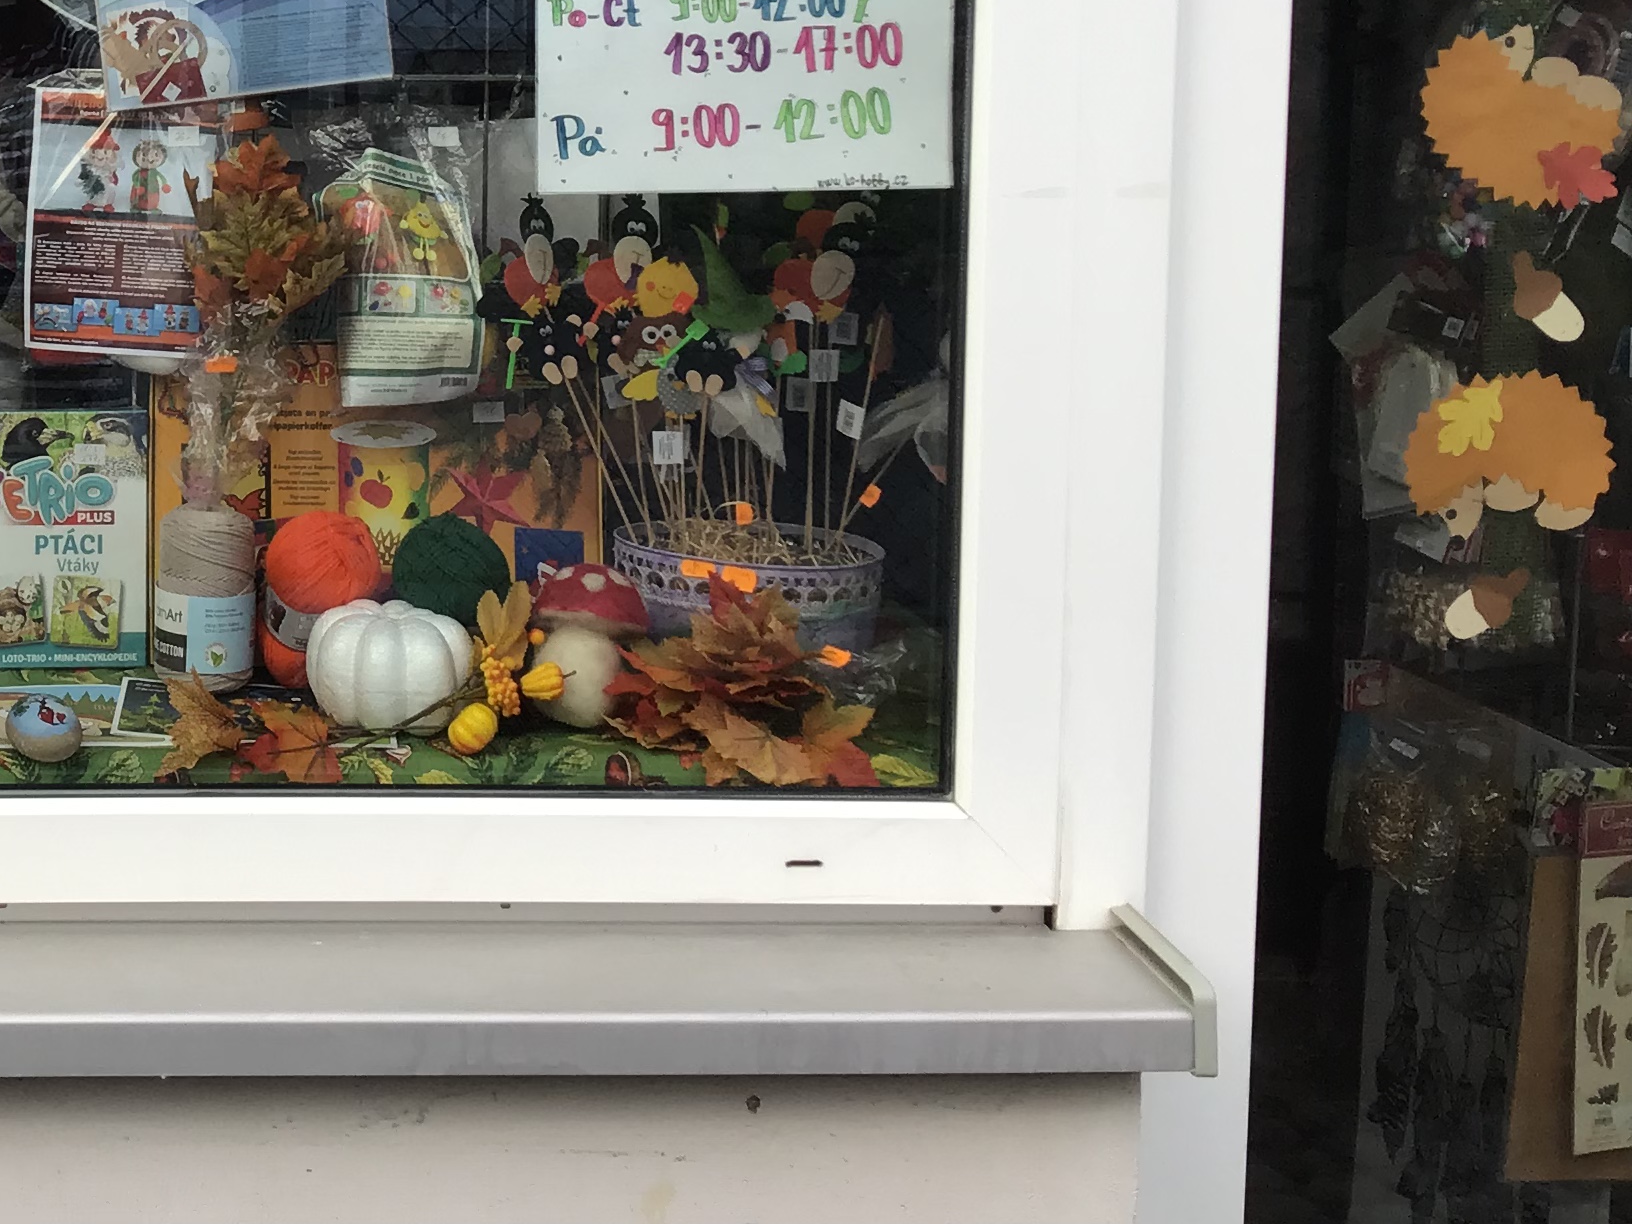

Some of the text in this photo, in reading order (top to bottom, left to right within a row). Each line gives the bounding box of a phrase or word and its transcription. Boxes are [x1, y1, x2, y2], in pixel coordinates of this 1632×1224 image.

[77, 511, 113, 523] PLUS
[35, 533, 103, 555] PTÁCI
[56, 557, 100, 575] Vtáky
[2, 654, 46, 663] LOTO-TRIO
[53, 652, 138, 664] MINI-ENCYKLOPEDIE
